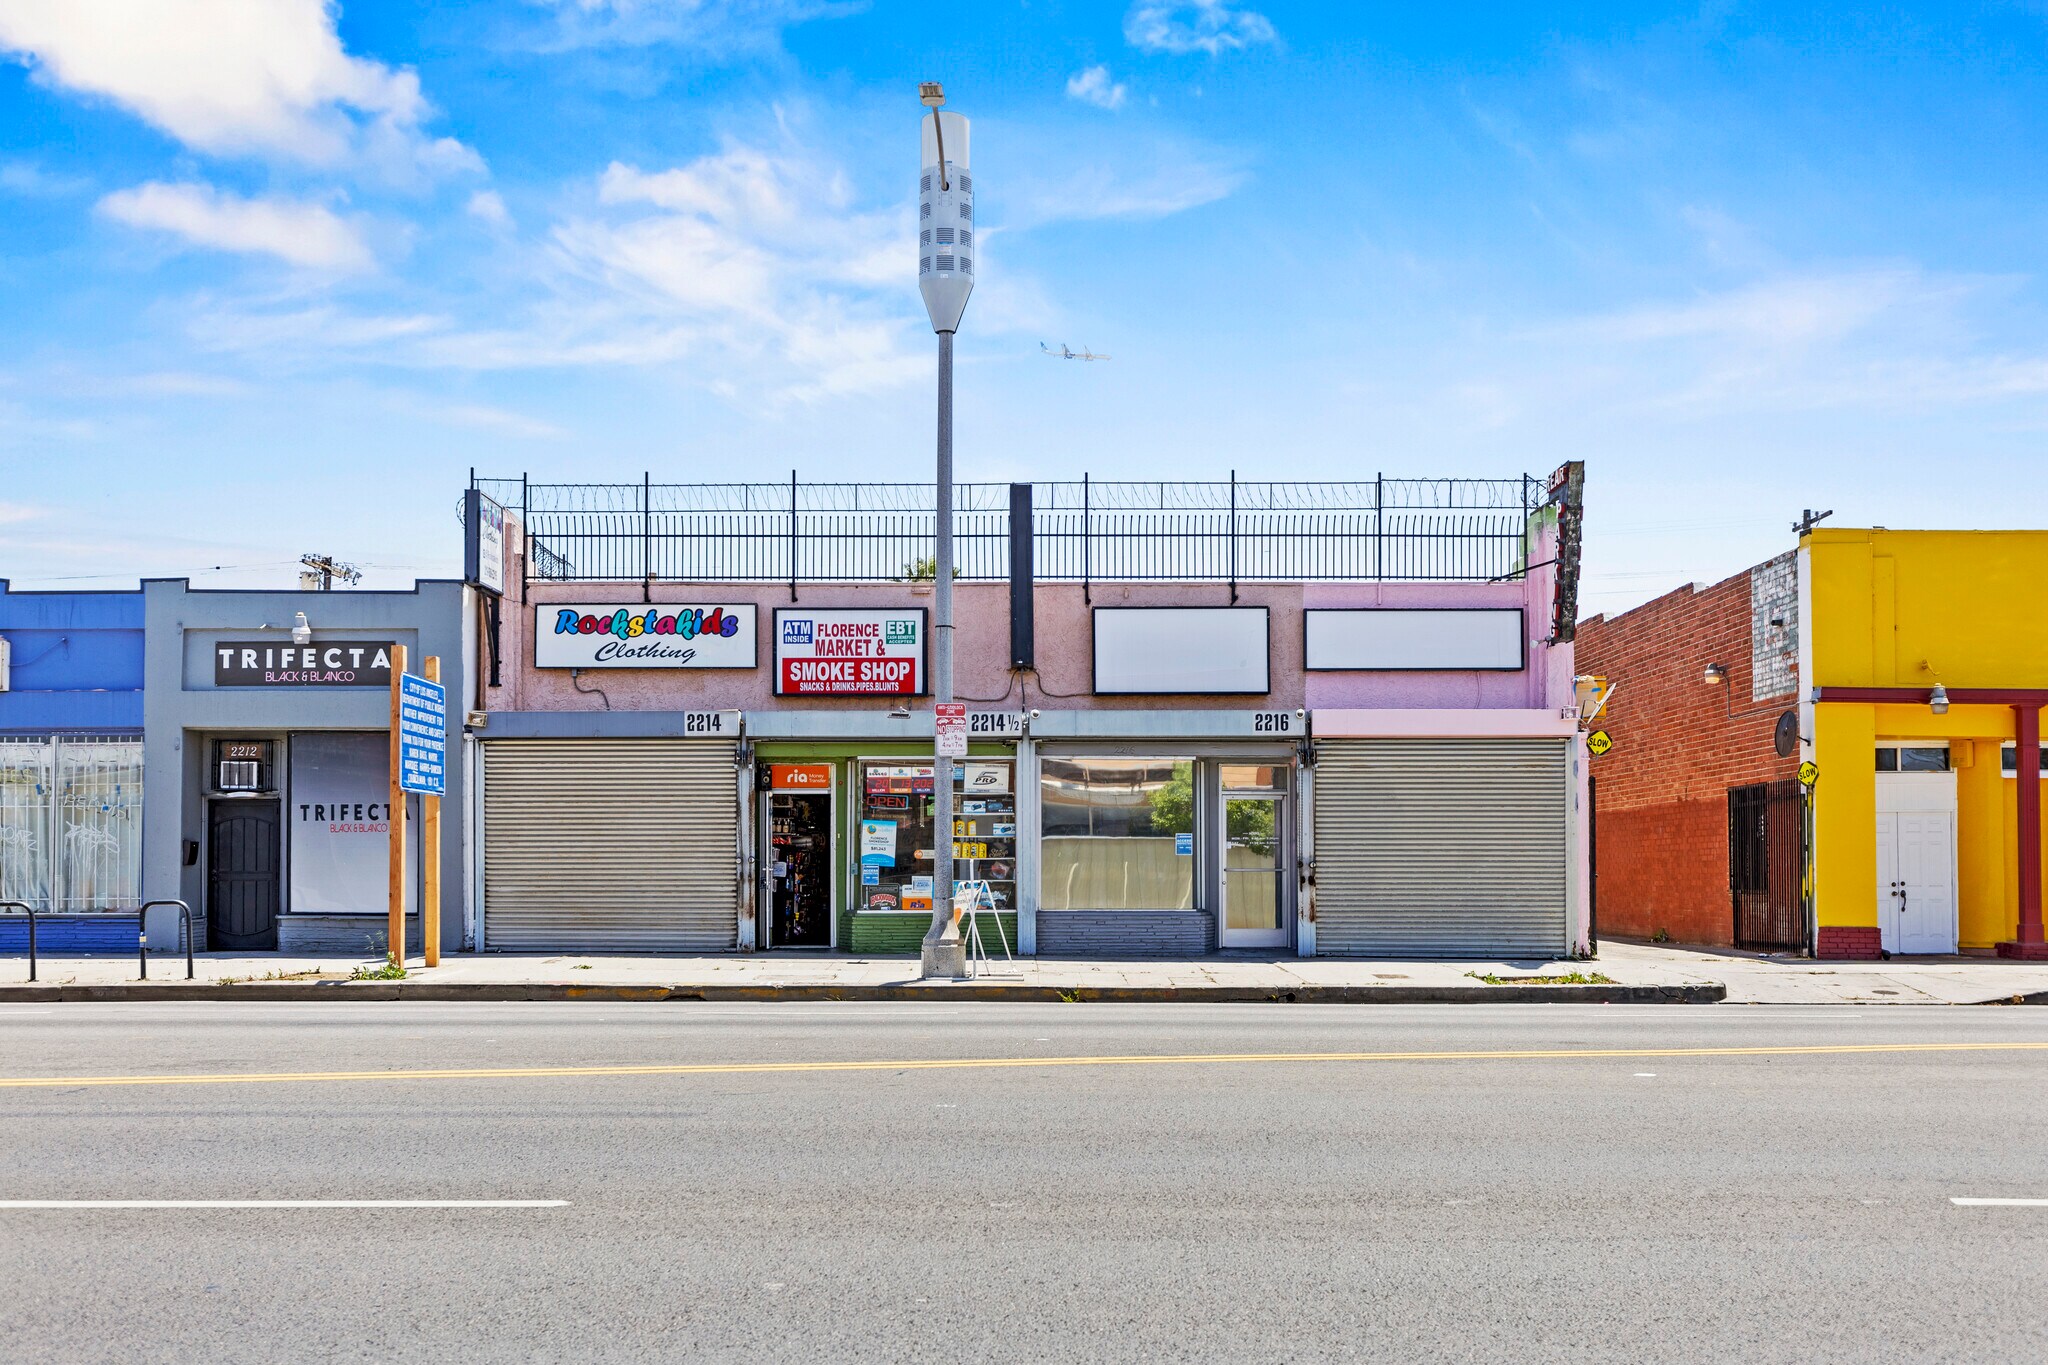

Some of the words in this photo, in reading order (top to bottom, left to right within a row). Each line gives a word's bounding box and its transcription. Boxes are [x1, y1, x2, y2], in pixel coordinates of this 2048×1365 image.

[555, 607, 738, 640] Rockstakids
[784, 622, 811, 634] ATM
[887, 621, 914, 634] EBT
[818, 624, 879, 637] FLORENCE
[594, 642, 697, 664] Clothing
[816, 639, 872, 656] MARKET
[876, 638, 886, 656] &
[219, 648, 391, 669] TRIFECTA
[265, 671, 300, 682] BLACK
[302, 671, 308, 682] &
[310, 671, 355, 682] BLANCO
[790, 662, 854, 681] SMOKE
[860, 662, 910, 681] SHOP
[800, 682, 824, 691] SNACKS
[826, 682, 830, 691] &
[687, 714, 722, 731] 2214
[971, 714, 1005, 731] 2214
[1255, 714, 1289, 731] 2216
[938, 725, 946, 734] NO
[1589, 738, 1608, 748] SLOW
[231, 746, 257, 756] 2212
[787, 769, 808, 782] ria
[1800, 768, 1816, 780] SLOW
[866, 796, 905, 807] OPEN
[330, 824, 352, 833] BLACK
[354, 824, 358, 833] &
[359, 824, 388, 833] BLANCO
